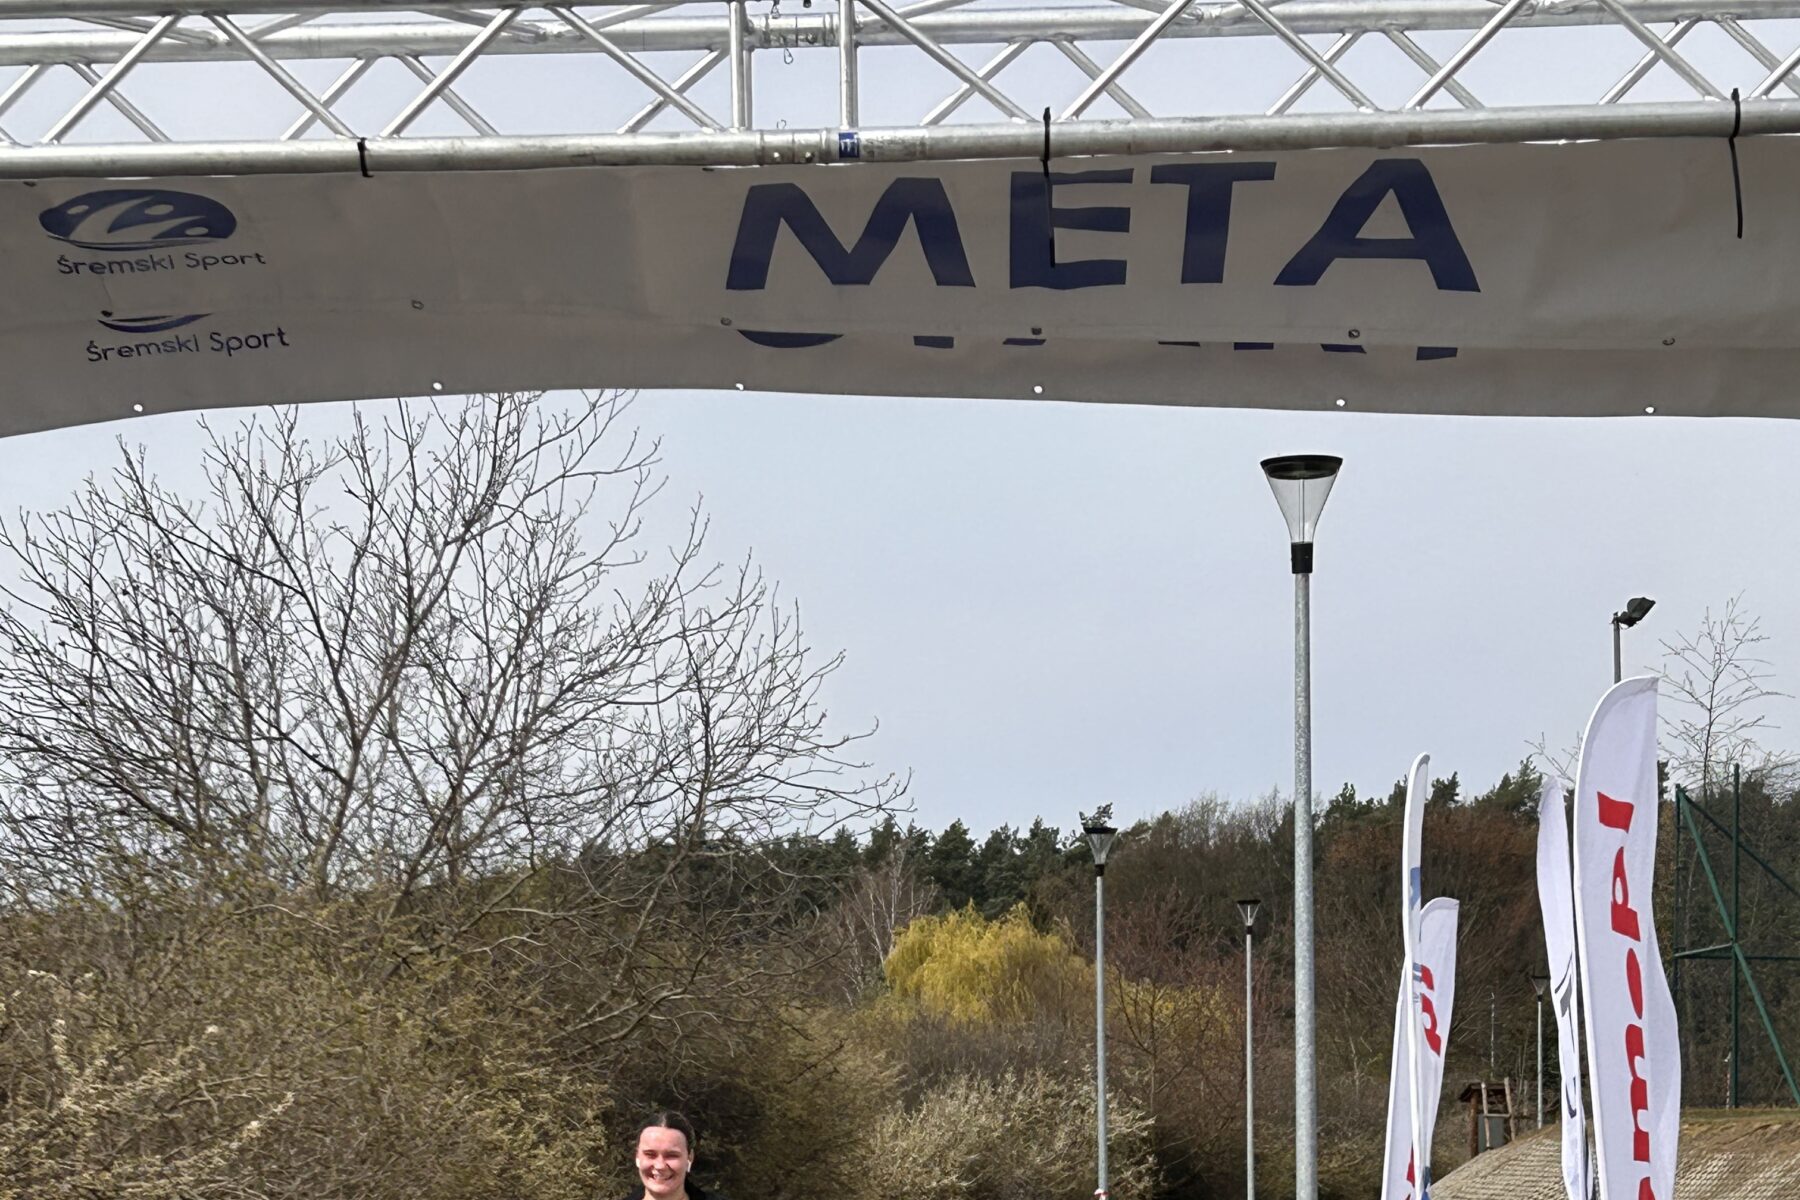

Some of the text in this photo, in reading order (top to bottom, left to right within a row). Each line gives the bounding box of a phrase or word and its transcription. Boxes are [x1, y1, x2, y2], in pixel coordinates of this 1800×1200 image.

[726, 157, 1481, 293] META
[57, 251, 267, 275] Śremski Sport
[86, 327, 290, 362] Śremski Sport
